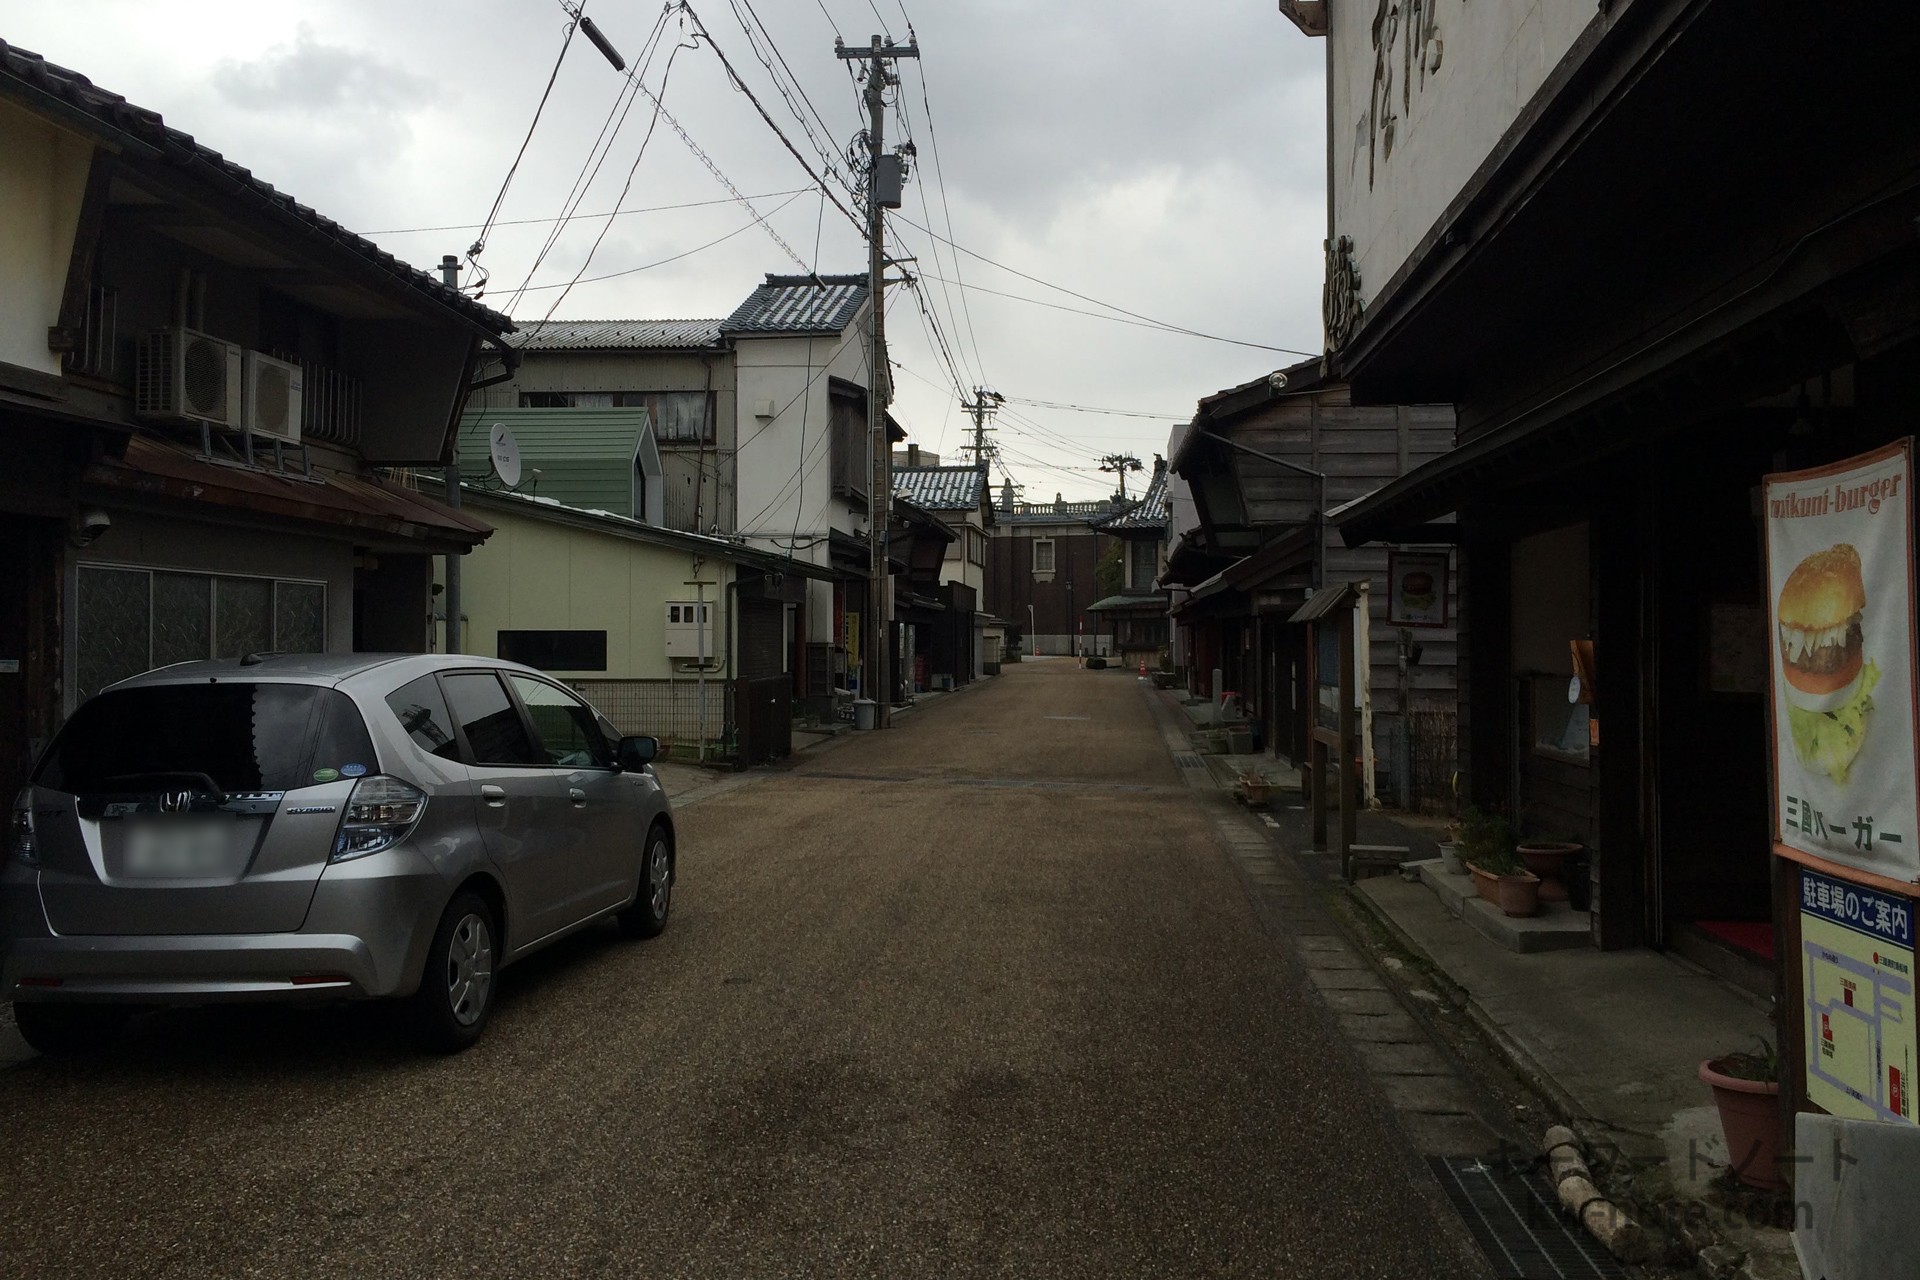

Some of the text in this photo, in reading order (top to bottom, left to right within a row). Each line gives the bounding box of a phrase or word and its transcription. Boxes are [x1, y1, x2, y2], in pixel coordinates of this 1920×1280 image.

[1770, 473, 1902, 518] mikuni-burger
[288, 806, 335, 814] HYBRID
[1786, 795, 1902, 851] 三国バーガー
[1803, 876, 1908, 940] 駐車場のご案内
